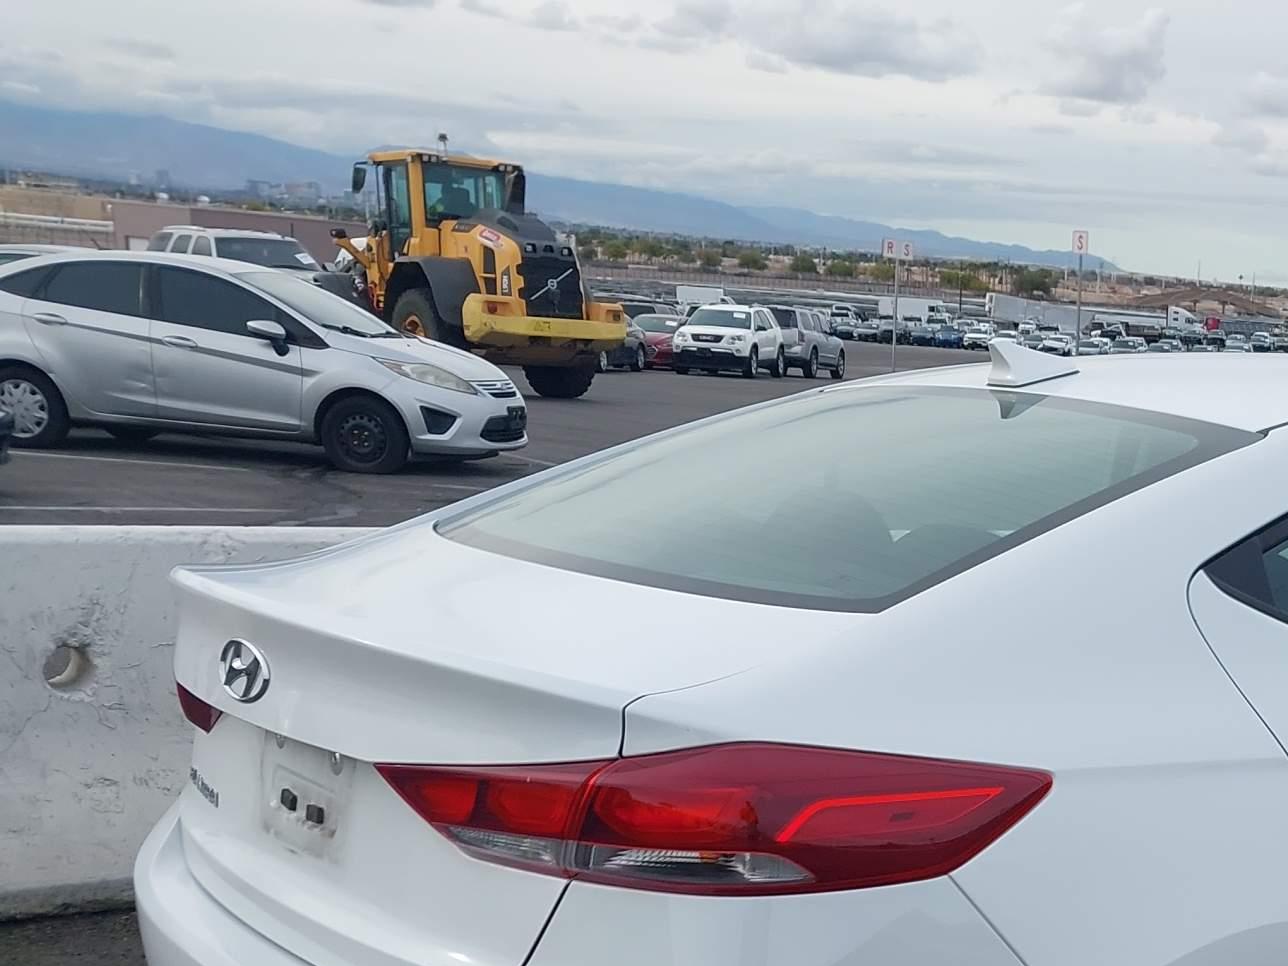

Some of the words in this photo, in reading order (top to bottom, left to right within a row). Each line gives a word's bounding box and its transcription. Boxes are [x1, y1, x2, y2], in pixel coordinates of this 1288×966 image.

[887, 241, 894, 254] R
[1077, 234, 1084, 250] S
[903, 243, 911, 257] S
